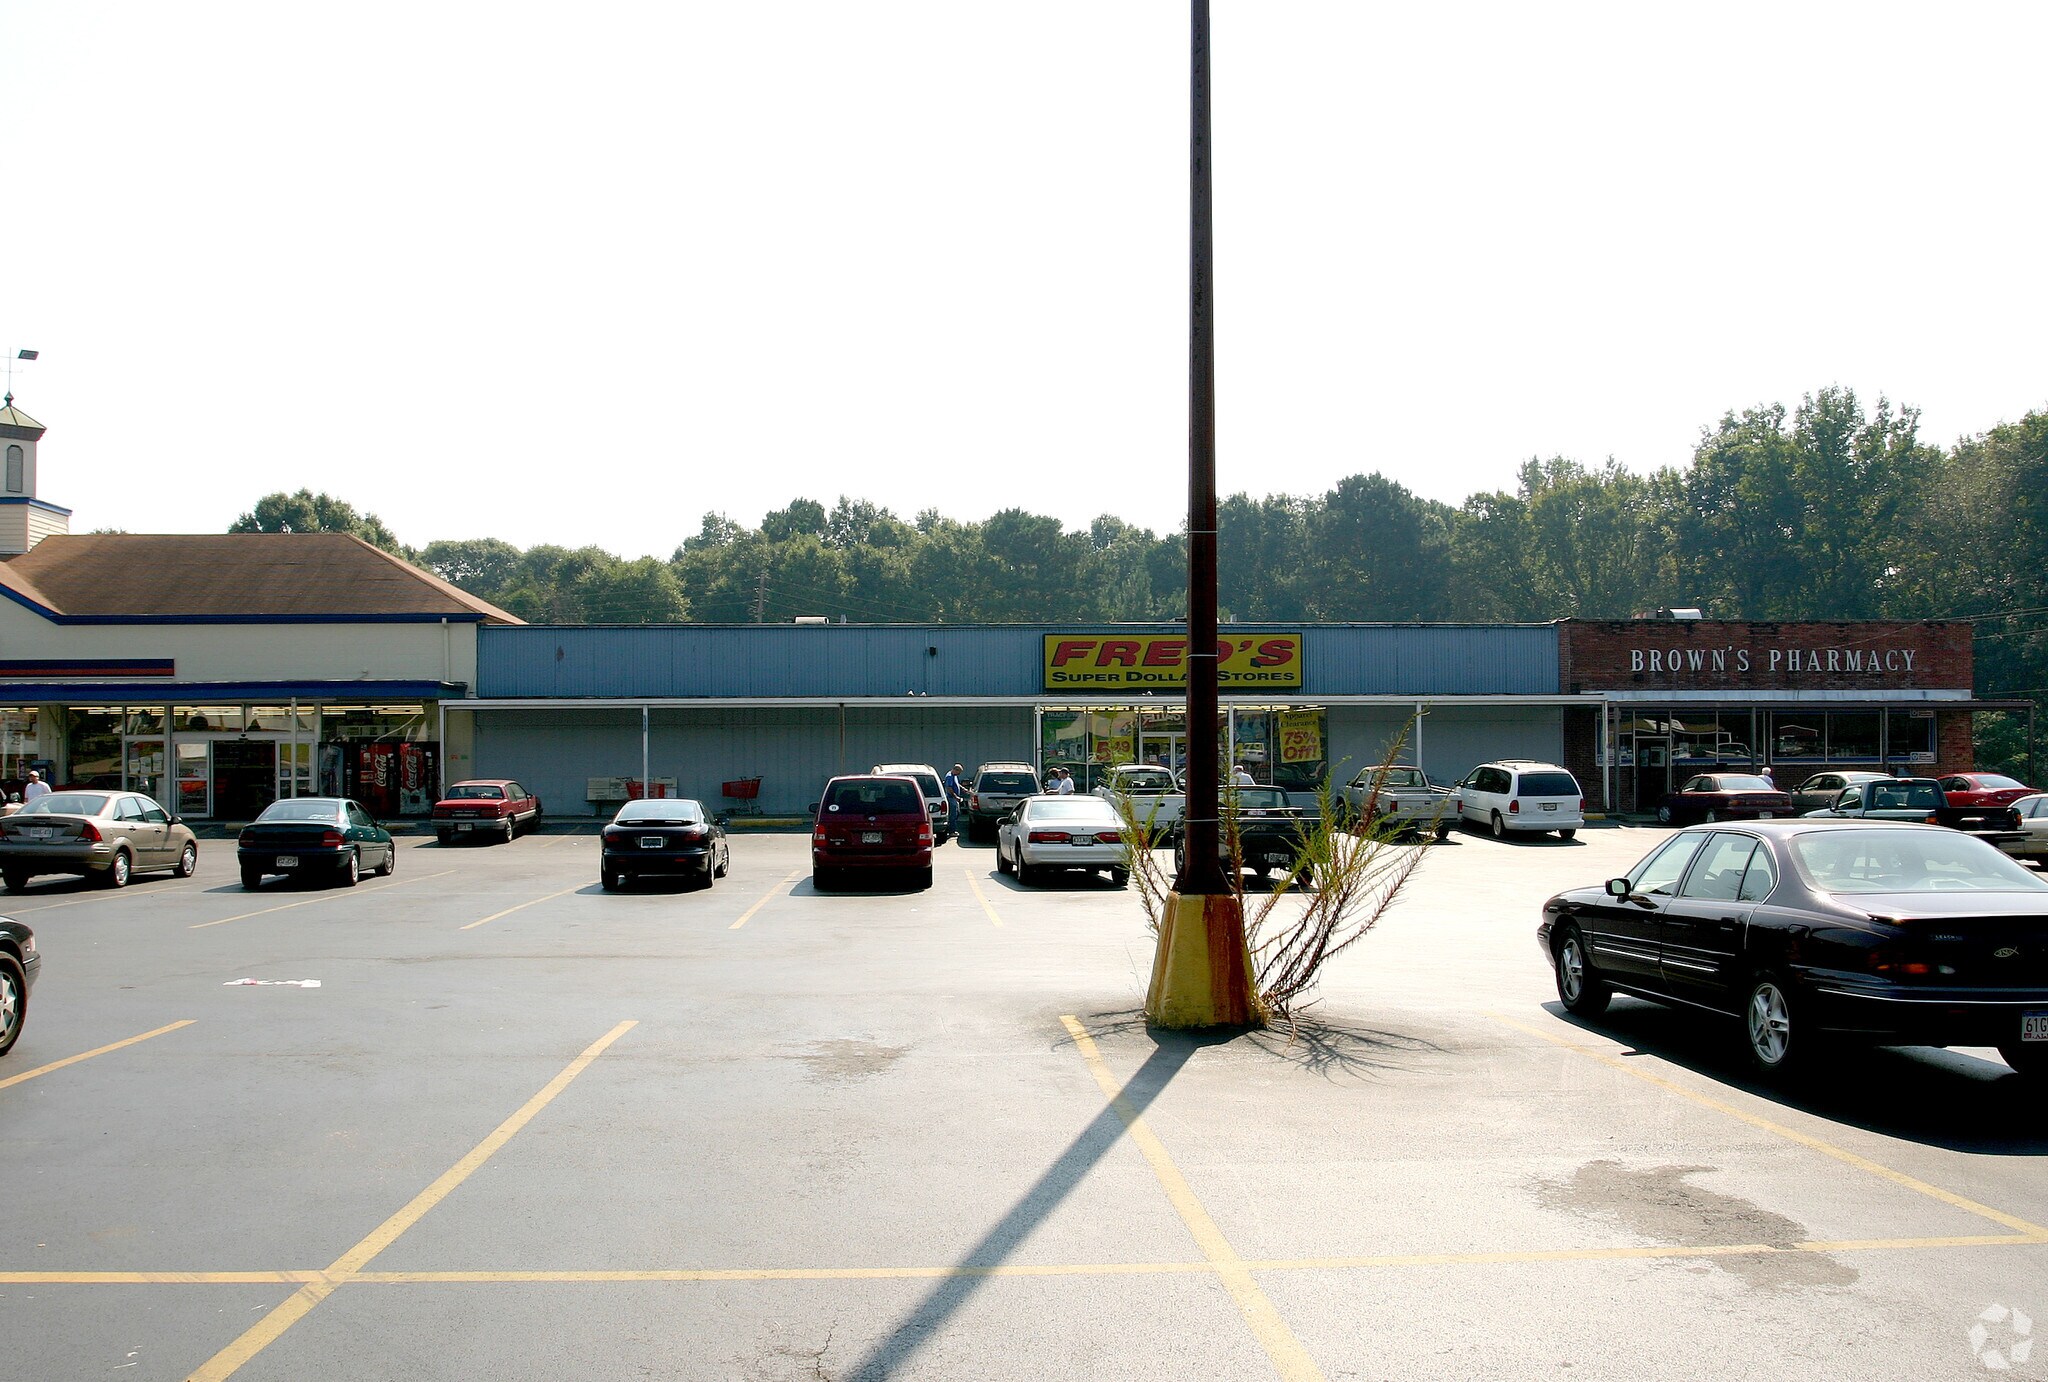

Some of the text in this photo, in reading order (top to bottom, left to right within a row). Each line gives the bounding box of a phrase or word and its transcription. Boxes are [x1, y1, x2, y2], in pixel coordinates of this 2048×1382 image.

[1630, 645, 1916, 672] BROWN'S PHARMACY
[1052, 671, 1295, 682] SUPER DOLLA STORES
[1284, 730, 1316, 745] 75%
[1283, 745, 1317, 760] Off!
[2025, 1017, 2048, 1033] 61G
